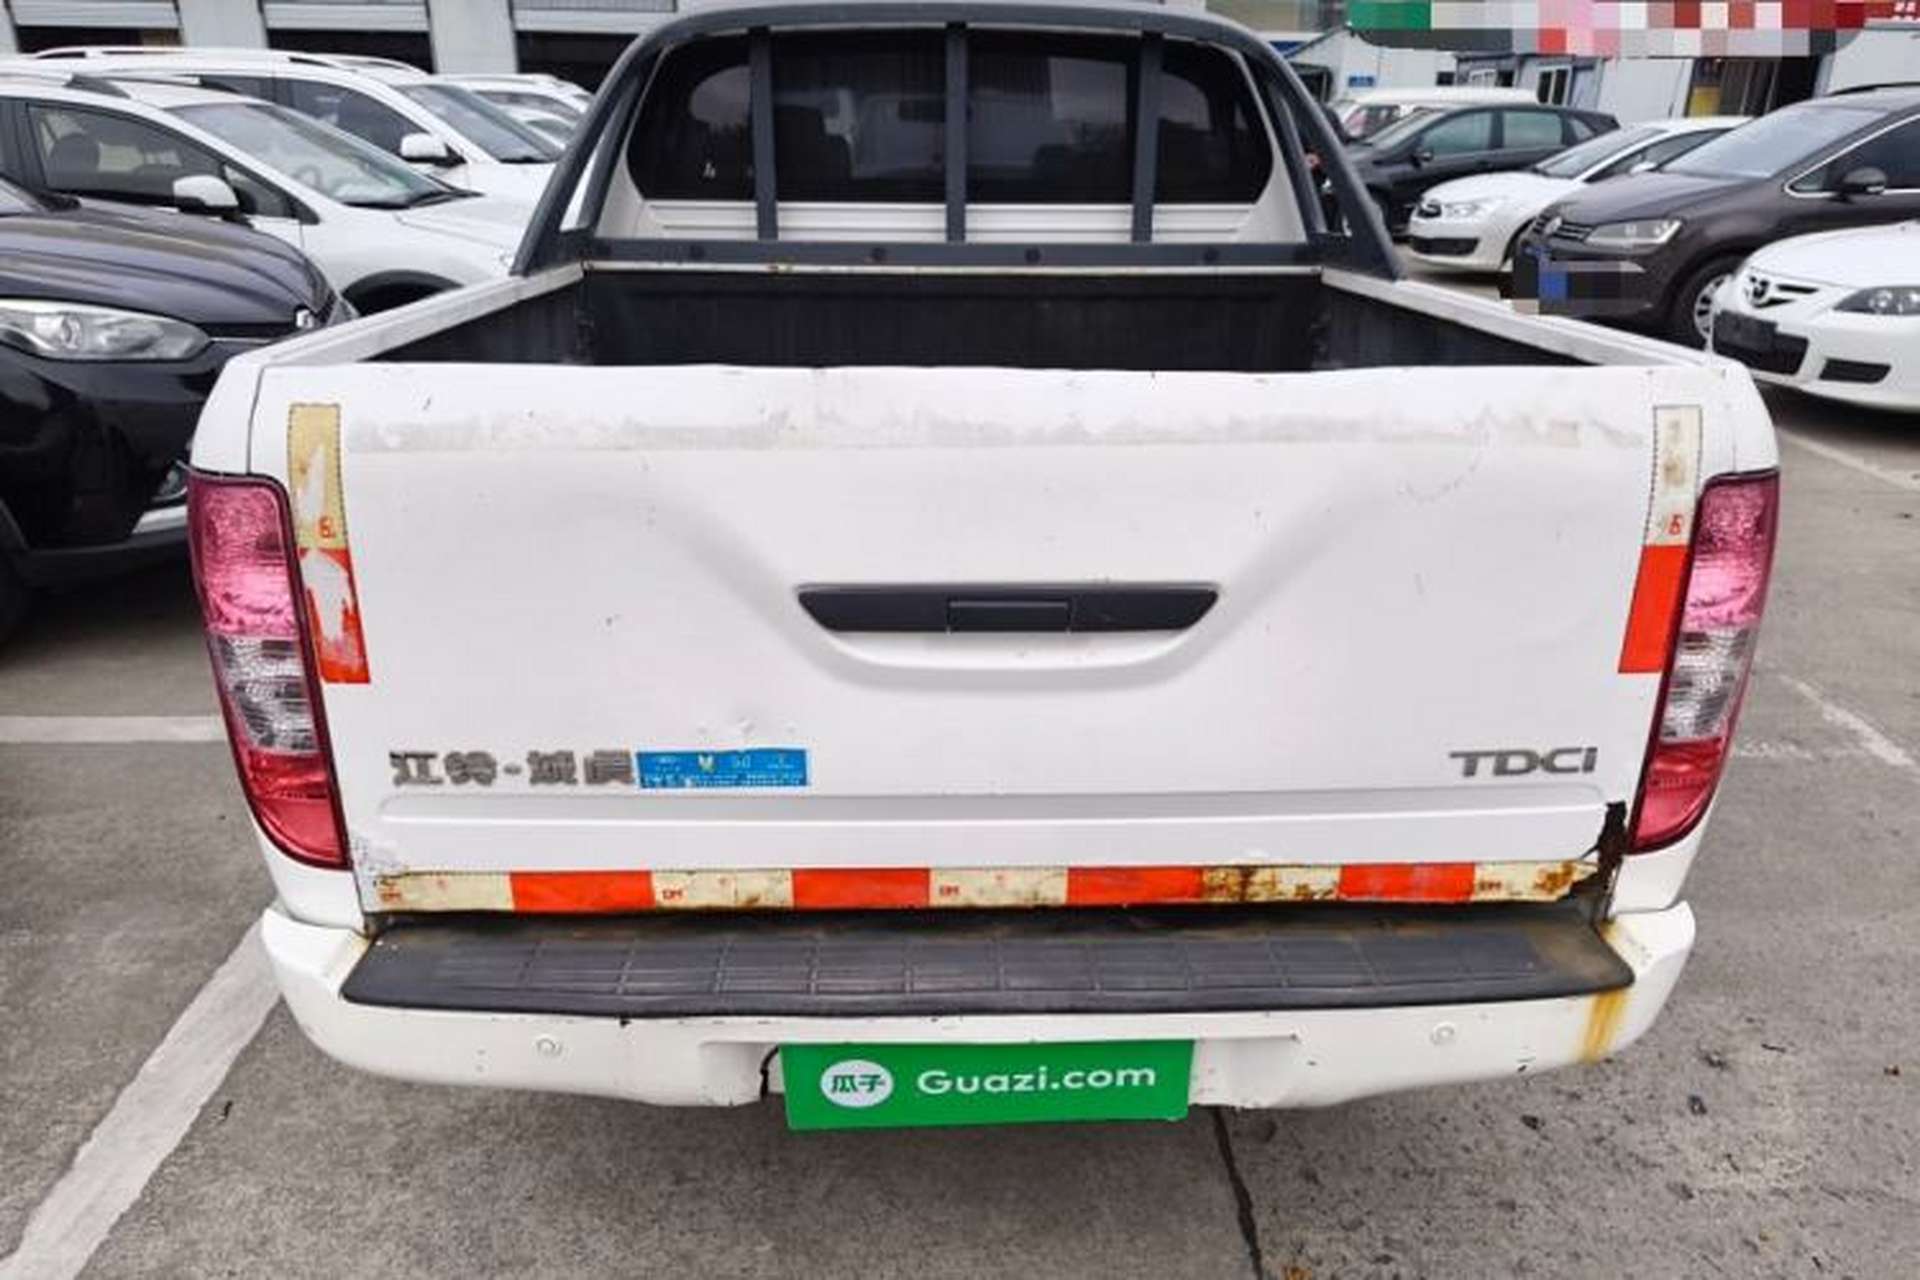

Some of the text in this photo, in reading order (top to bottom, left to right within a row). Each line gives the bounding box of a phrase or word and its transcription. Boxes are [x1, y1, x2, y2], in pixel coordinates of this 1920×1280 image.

[1449, 747, 1598, 777] TDCI
[831, 1074, 886, 1094] 瓜子
[917, 1066, 1156, 1095] Guazi.com
